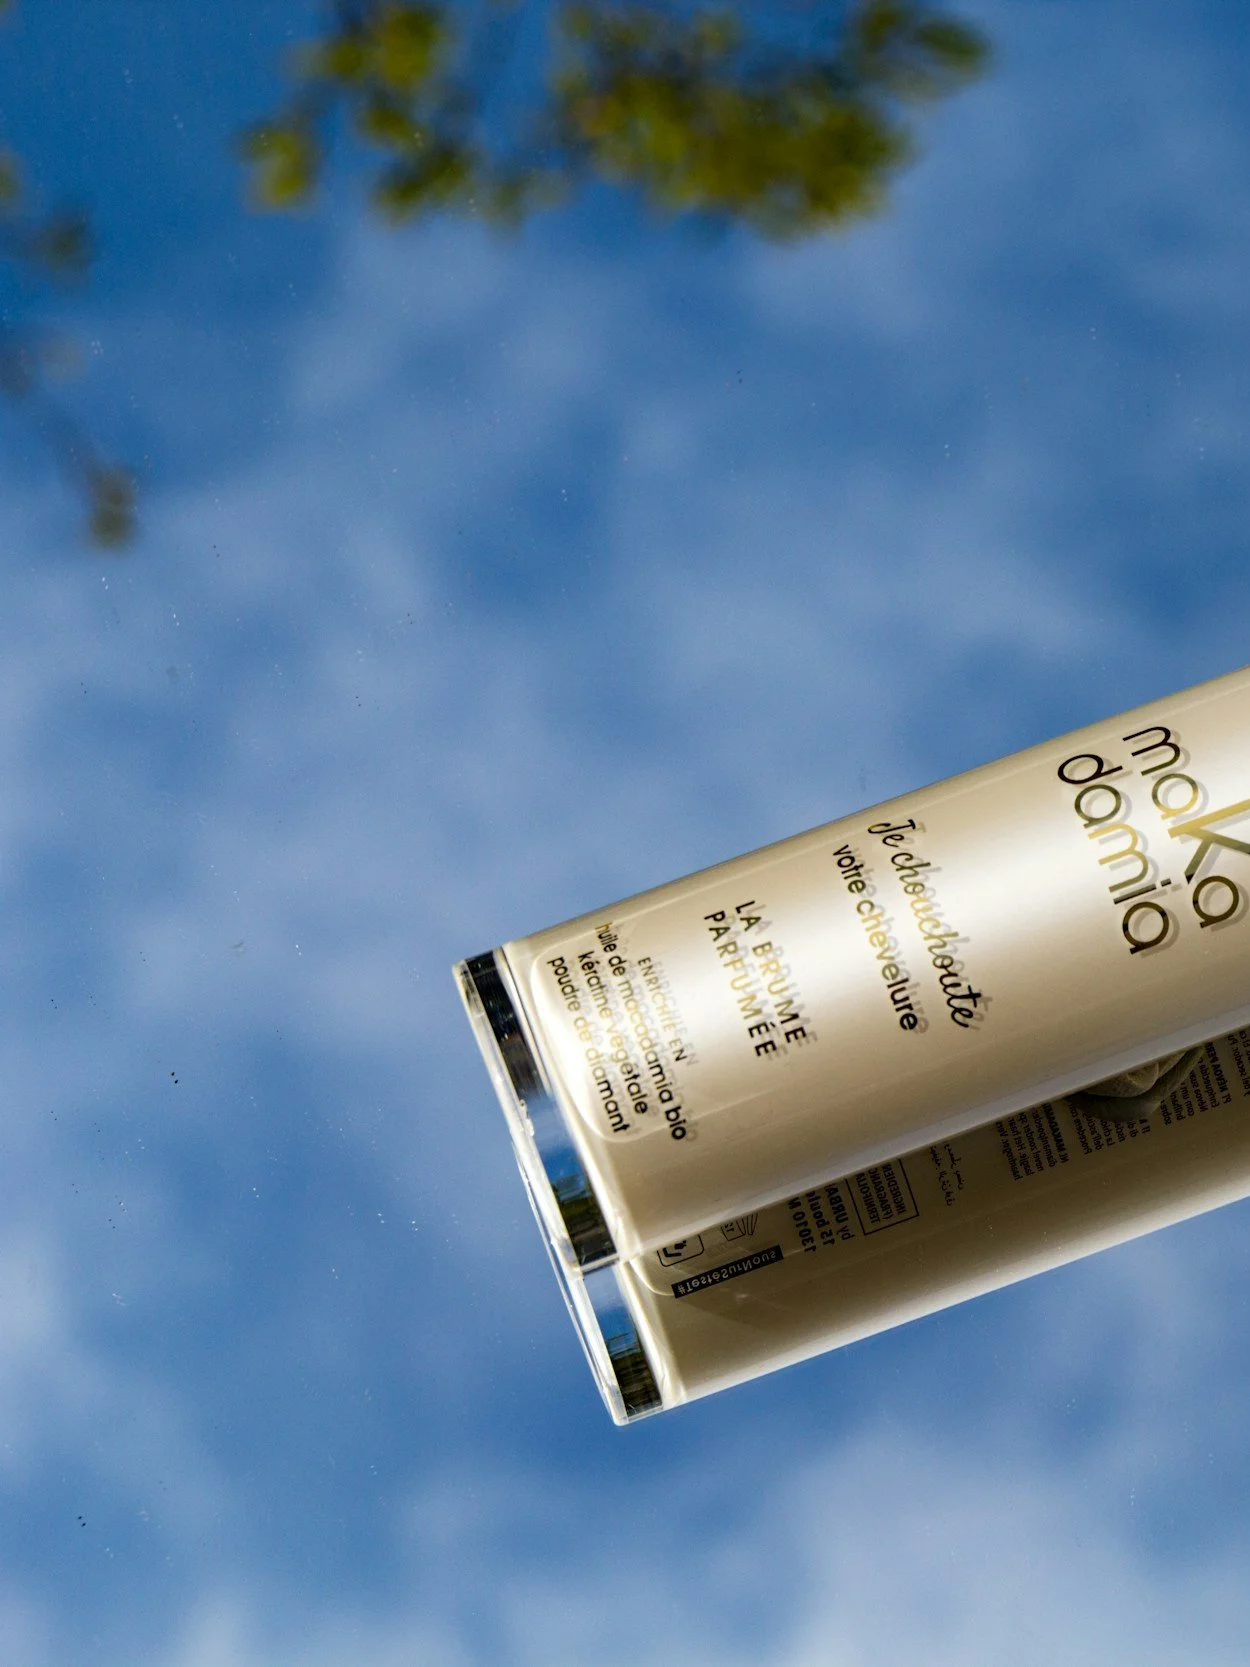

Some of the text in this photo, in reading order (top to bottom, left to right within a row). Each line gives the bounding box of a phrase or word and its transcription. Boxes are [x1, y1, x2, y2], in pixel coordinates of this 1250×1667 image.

[832, 844, 919, 1033] votre chevelure
[866, 818, 981, 1028] Je chouchoute
[1057, 752, 1172, 955] damia
[546, 956, 629, 1135] poudre de diamant
[576, 950, 648, 1116] kératine végétale
[594, 922, 687, 1141] huile de macadamia bio
[636, 956, 687, 1063] ENRICHIE EN
[702, 910, 776, 1058] PARFUMÉE
[734, 900, 806, 1045] LA BRUME
